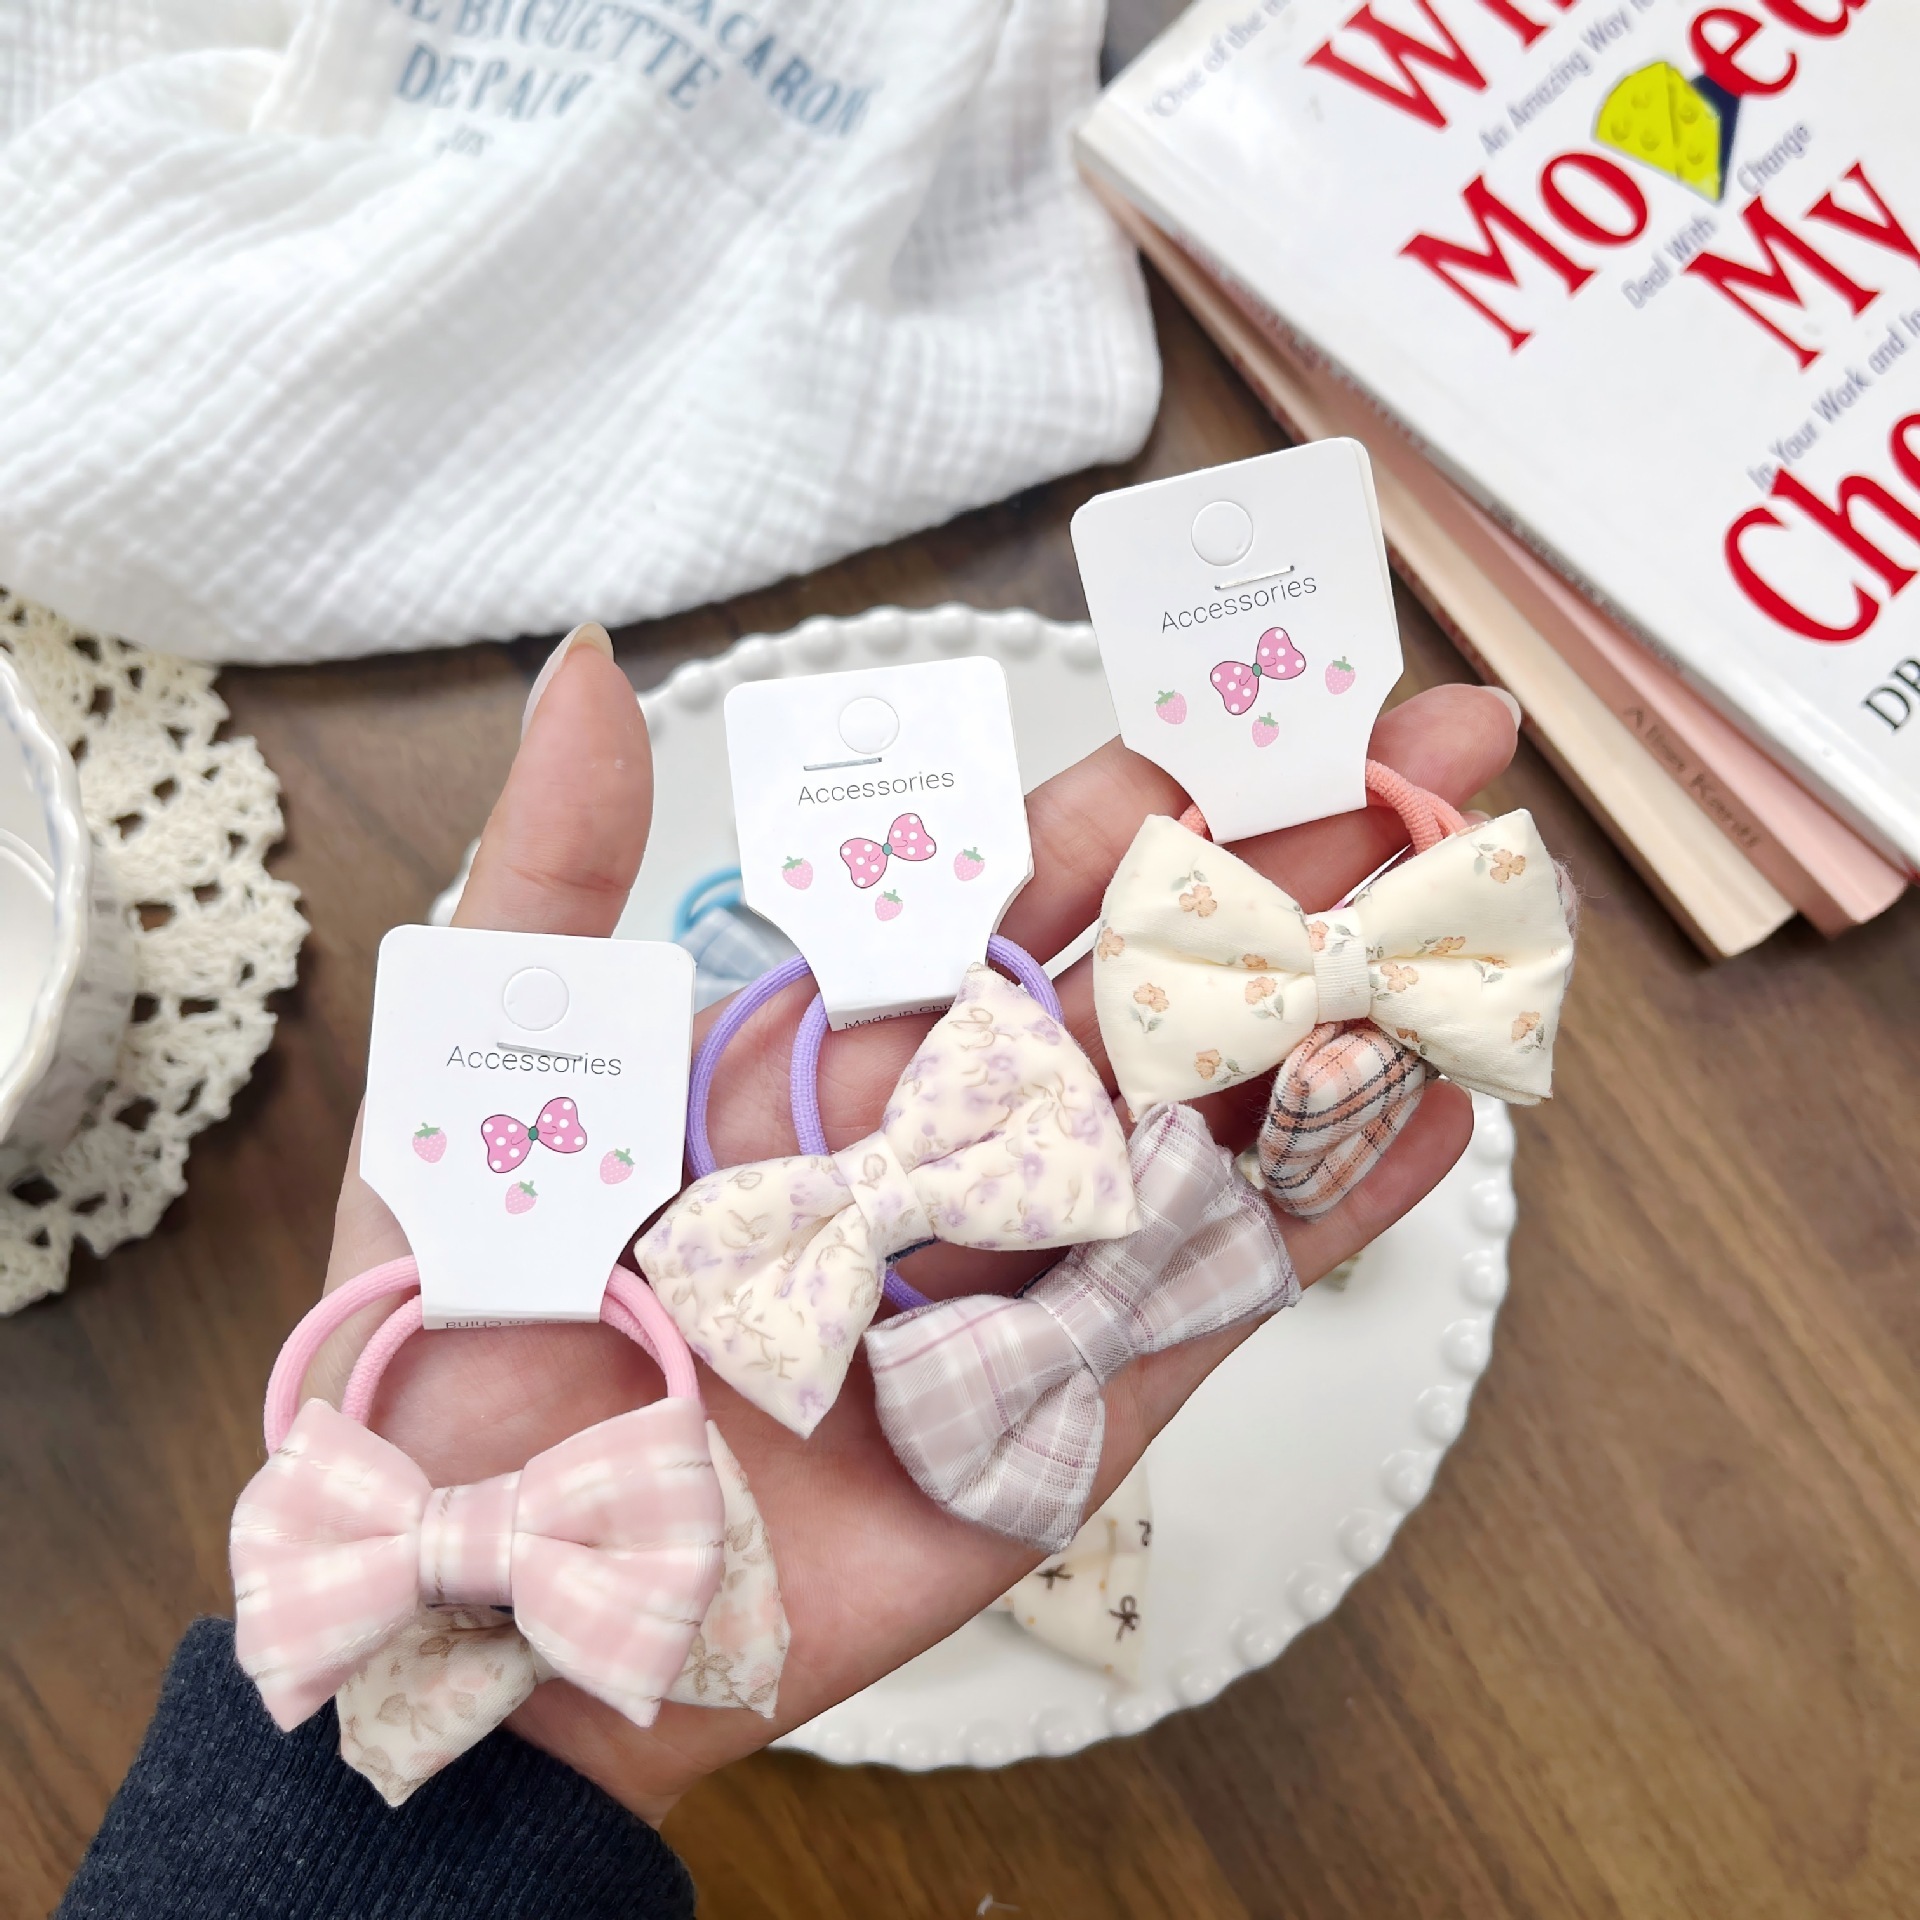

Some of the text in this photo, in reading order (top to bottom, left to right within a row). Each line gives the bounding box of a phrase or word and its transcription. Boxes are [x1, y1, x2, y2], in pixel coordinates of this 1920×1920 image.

[1481, 125, 1510, 155] An
[1507, 51, 1593, 129] Amazing
[1581, 9, 1633, 55] Way
[1621, 120, 1812, 309] Deal With Change
[1769, 417, 1820, 466] Your
[1811, 366, 1873, 424] Work
[1868, 321, 1908, 375] and
[1162, 577, 1317, 633] Accessories
[798, 771, 955, 806] Accessories
[447, 1045, 622, 1076] Accessories
